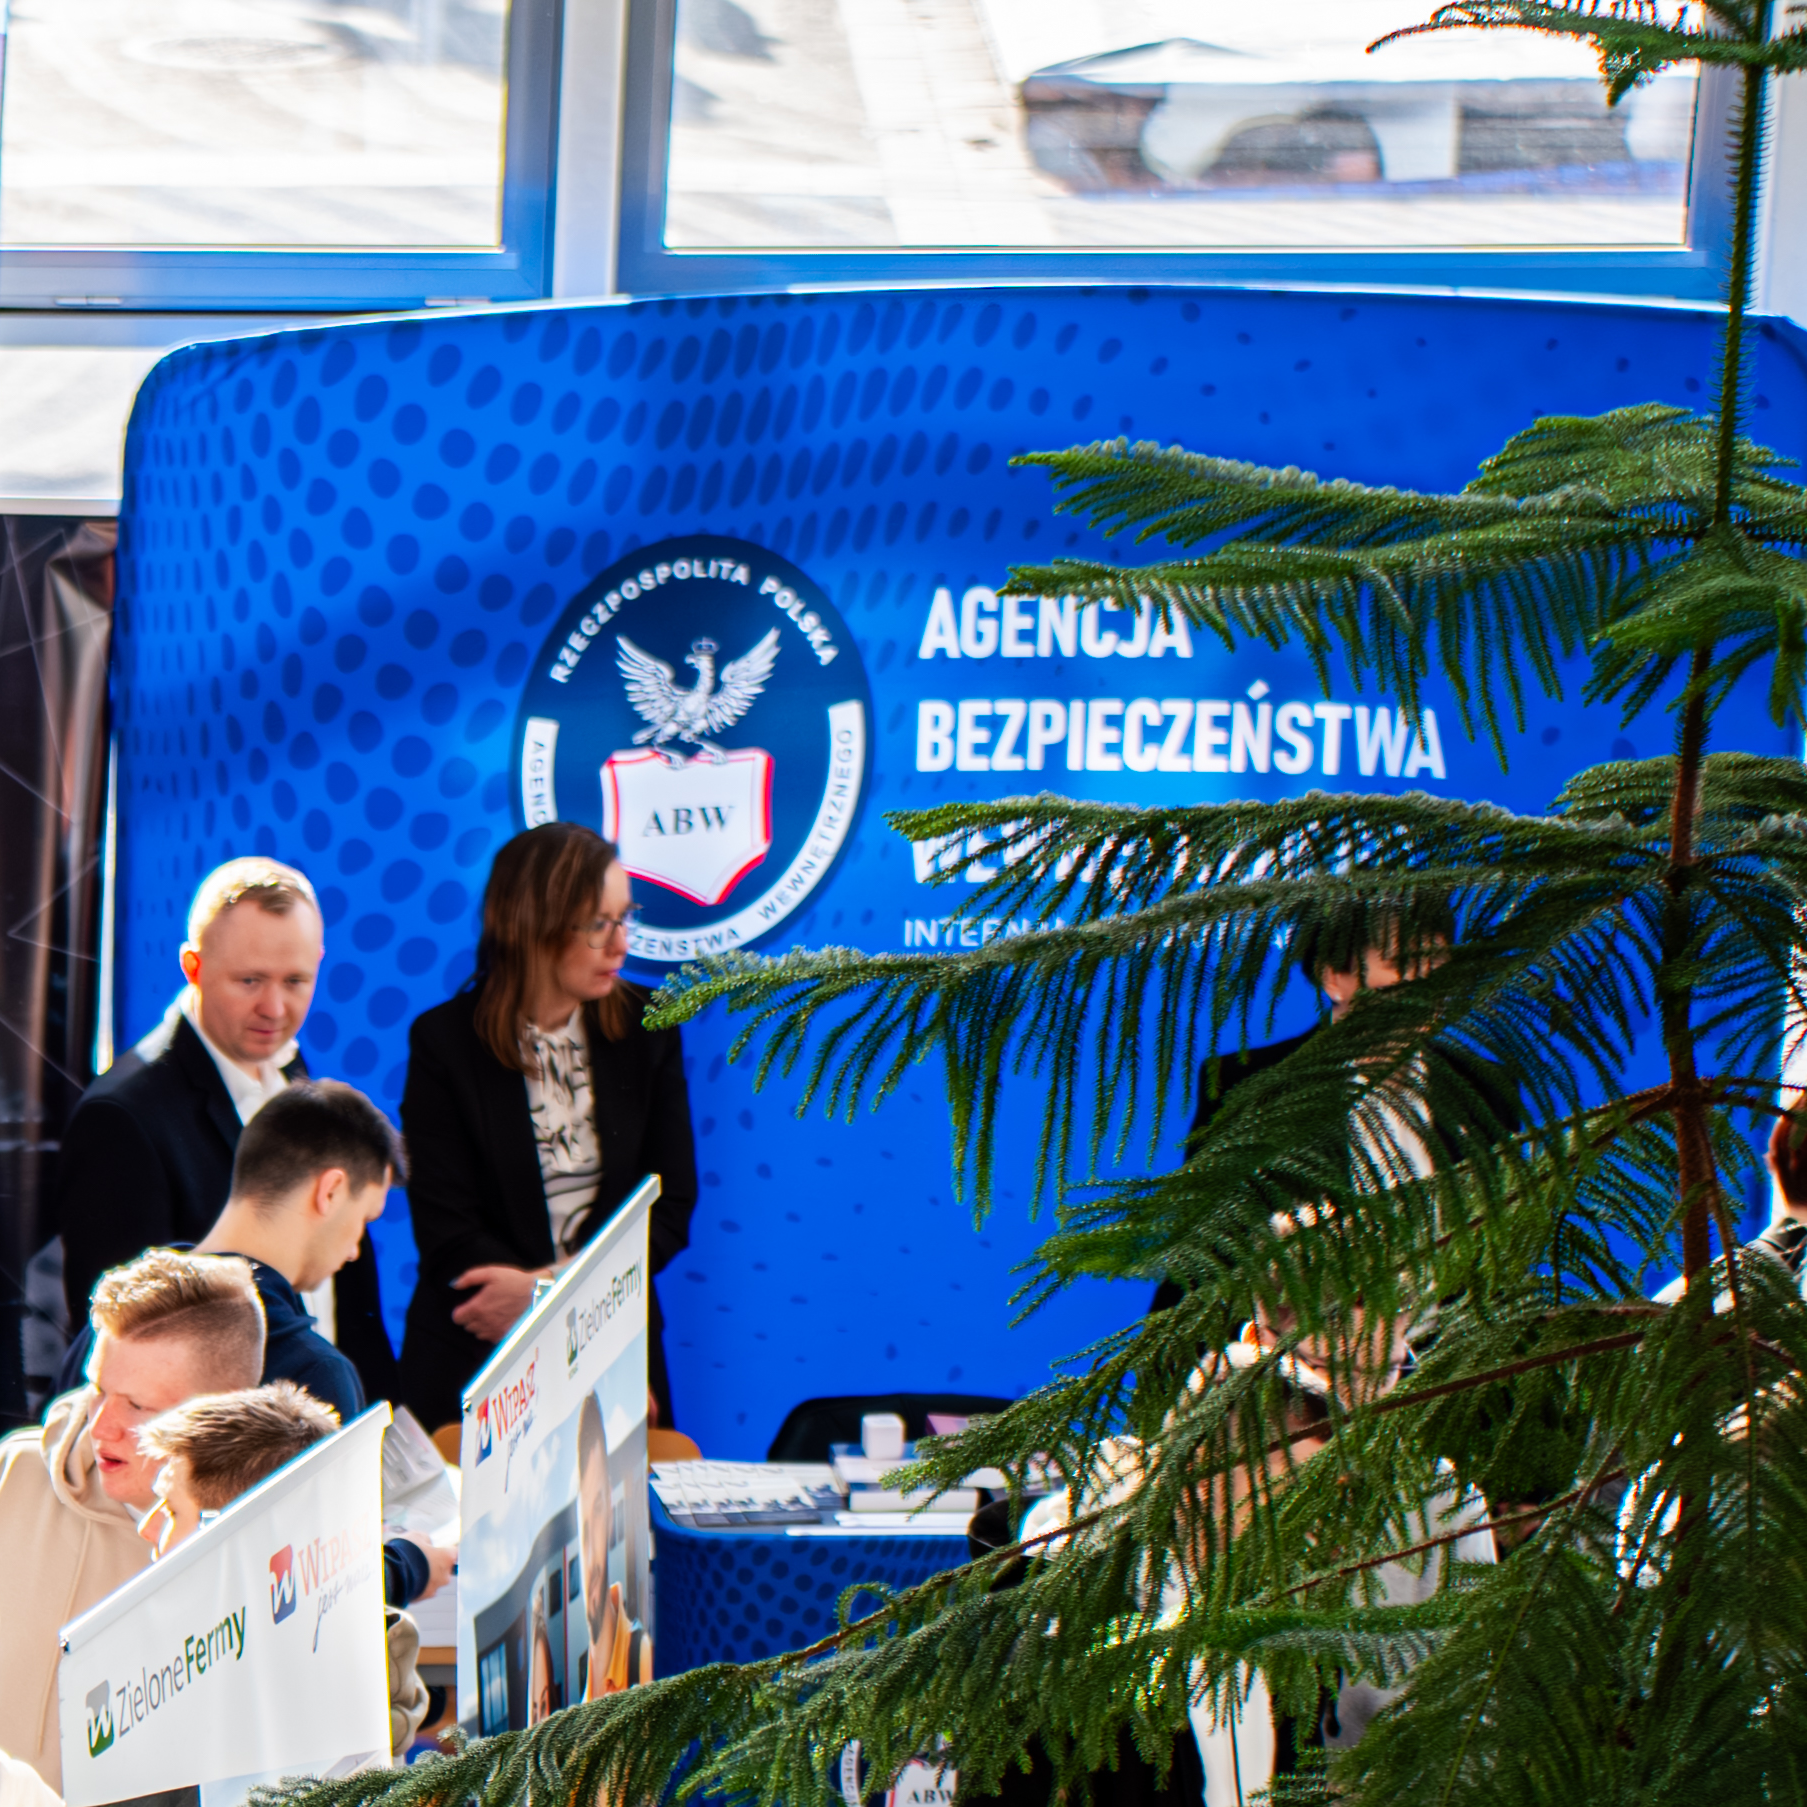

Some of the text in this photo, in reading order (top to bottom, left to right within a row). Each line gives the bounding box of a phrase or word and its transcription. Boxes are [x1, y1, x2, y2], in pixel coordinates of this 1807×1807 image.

[549, 557, 840, 684] RZECZPOSPOLITA POLSKA
[918, 586, 1192, 660] AGENCJA
[914, 679, 1448, 780] BEZPIECZEŃSTWA
[642, 805, 733, 838] ABW
[758, 728, 853, 922] WEWNĘTRZNEGO
[577, 1257, 643, 1352] ZieloneFermy
[492, 1361, 536, 1442] WIPASZ
[115, 1605, 247, 1738] ZieloneFermy
